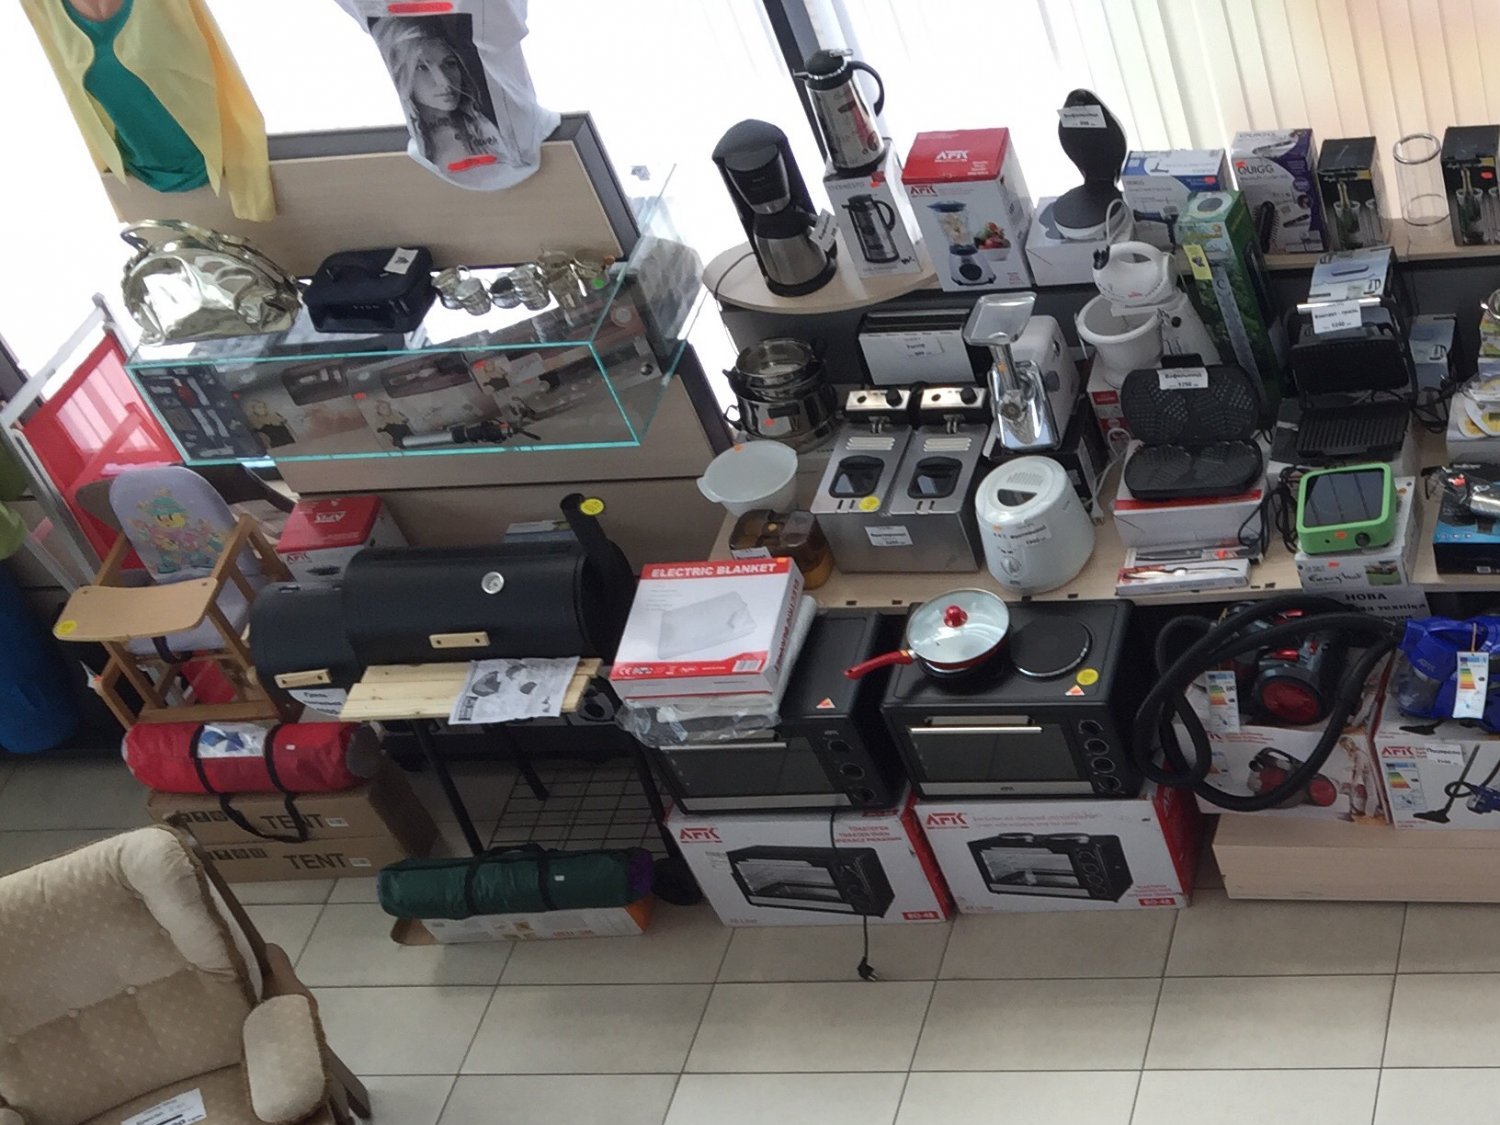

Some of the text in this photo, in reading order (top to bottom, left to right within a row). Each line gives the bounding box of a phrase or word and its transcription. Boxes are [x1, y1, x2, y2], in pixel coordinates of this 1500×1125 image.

[1237, 164, 1275, 174] QUIGG
[651, 563, 778, 578] ELECTRIC BLANKET
[1344, 593, 1388, 601] НОВА
[926, 812, 968, 826] AFK
[679, 827, 721, 841] AFK
[282, 853, 348, 870] TENT
